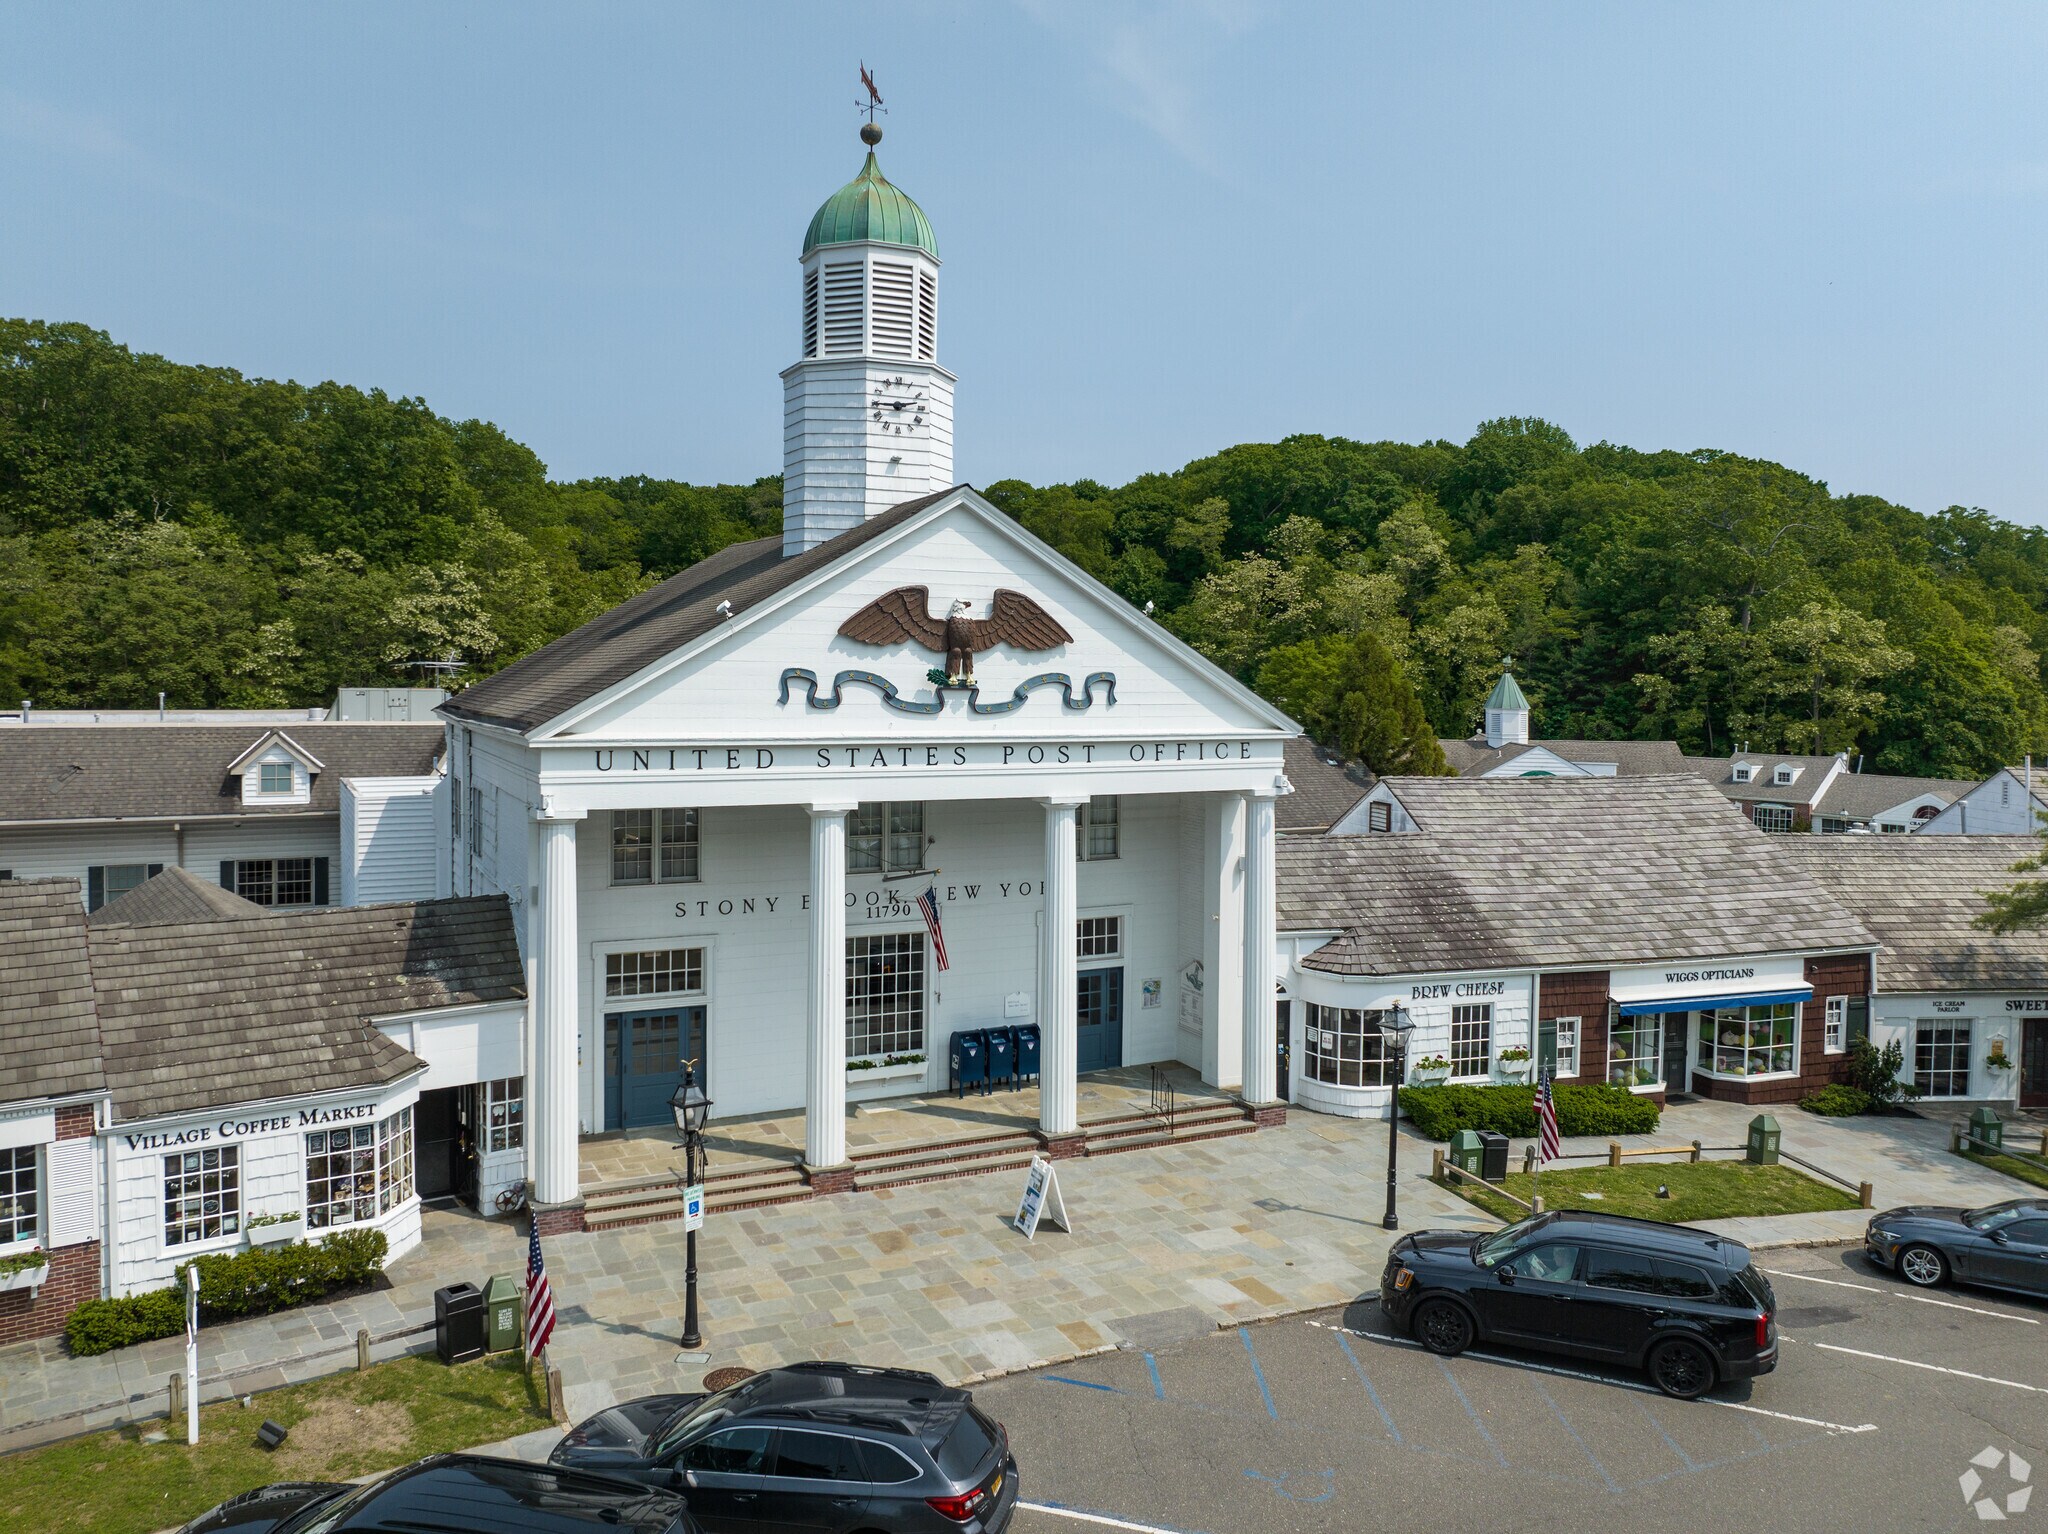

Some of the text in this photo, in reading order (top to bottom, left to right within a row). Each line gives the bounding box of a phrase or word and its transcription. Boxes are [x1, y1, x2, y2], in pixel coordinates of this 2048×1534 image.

[595, 740, 1251, 771] UNITED STATES POST OFFICE
[675, 897, 779, 917] STONY
[1000, 881, 1045, 898] YO
[866, 904, 911, 919] 11790
[1665, 968, 1755, 983] WIGGS OPTICIANS
[1412, 981, 1505, 999] BREW CHEESE
[125, 1127, 211, 1151] VILLAGE
[218, 1115, 291, 1137] COFFEE
[298, 1103, 378, 1126] MARKET
